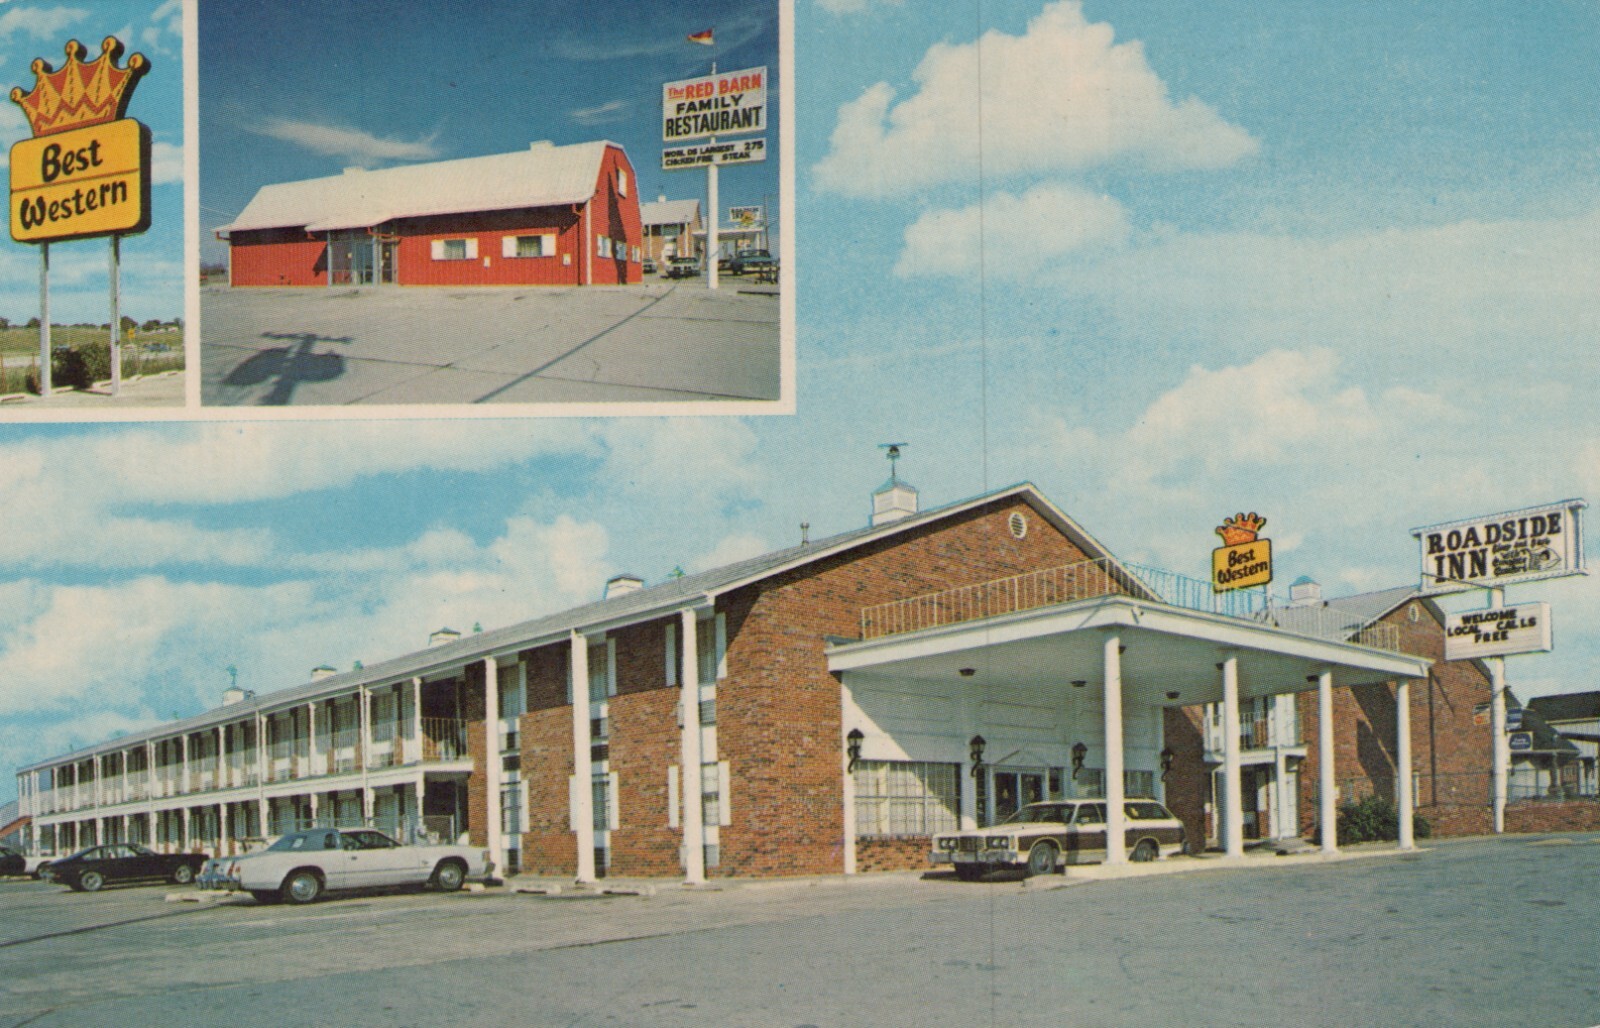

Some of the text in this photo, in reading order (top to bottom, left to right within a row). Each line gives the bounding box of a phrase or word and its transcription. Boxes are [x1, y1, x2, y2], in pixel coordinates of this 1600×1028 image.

[668, 73, 762, 99] The RED BARN
[676, 93, 744, 115] FAMILY
[665, 105, 763, 137] RESTAURANT
[722, 151, 751, 161] STEAK
[744, 140, 764, 151] 275
[42, 139, 103, 183] Best
[20, 180, 127, 230] Western
[1427, 512, 1562, 554] ROADSIDE
[1228, 549, 1256, 567] Best
[1434, 548, 1488, 583] INN
[1217, 561, 1268, 584] Western
[1447, 616, 1537, 638] LOCAL CALLS
[1461, 609, 1518, 625] WELCOME
[1474, 630, 1509, 643] FREE
